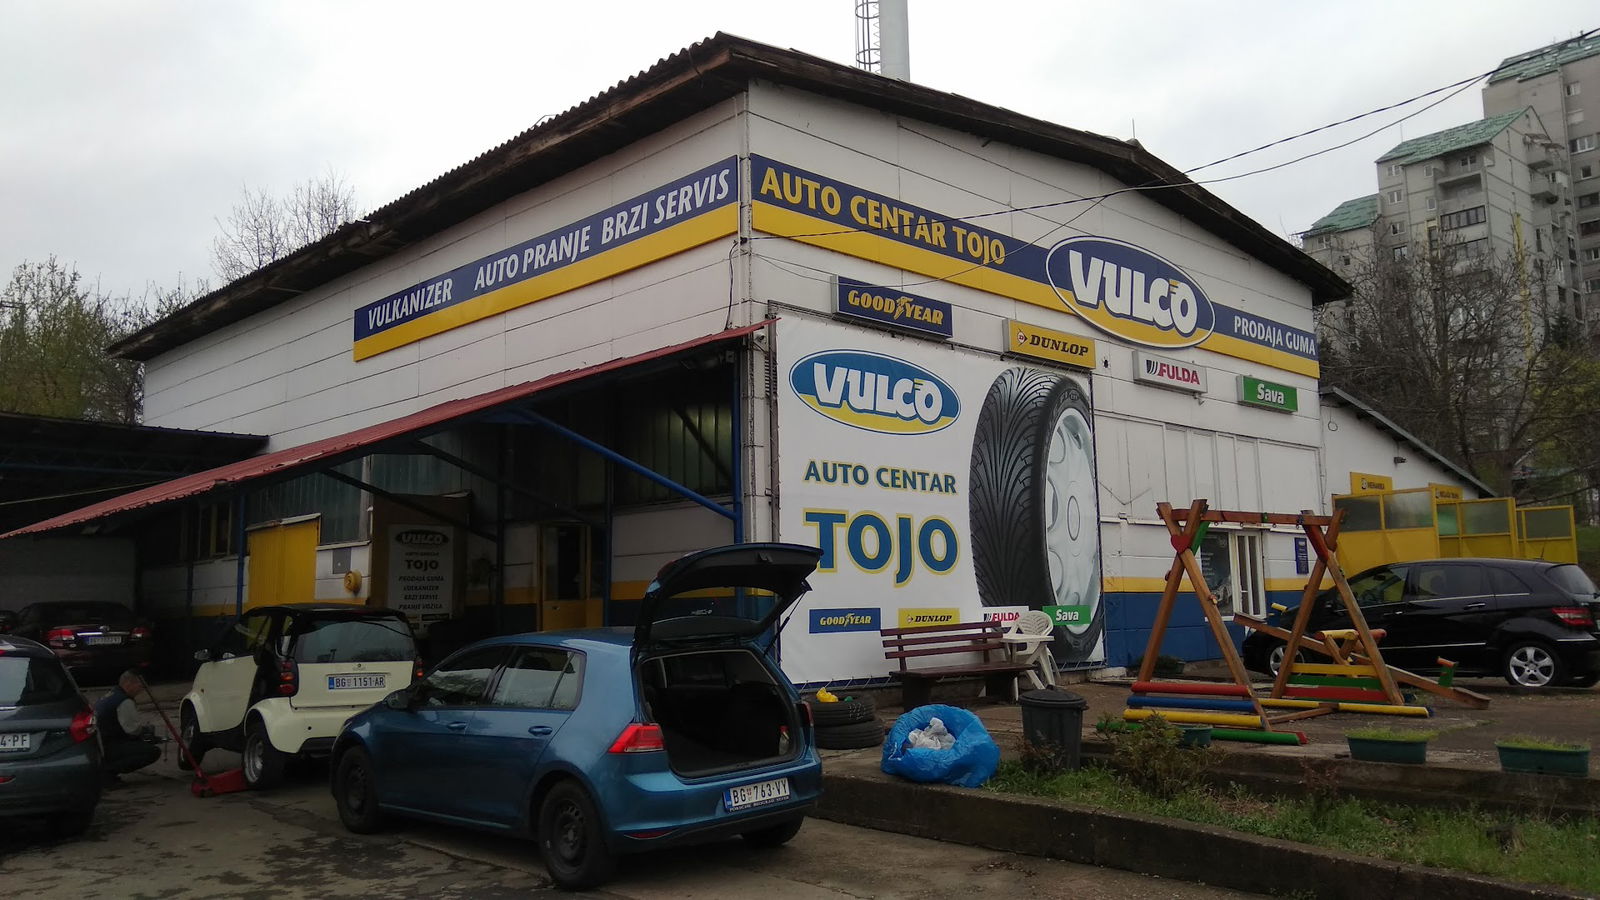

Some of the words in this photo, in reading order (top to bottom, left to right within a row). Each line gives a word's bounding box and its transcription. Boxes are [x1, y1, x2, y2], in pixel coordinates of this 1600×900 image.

[760, 166, 842, 216] AUTO
[850, 195, 947, 249] CENTAR
[953, 225, 1006, 265] TOJO
[368, 278, 453, 330] VULKANIZER
[474, 253, 519, 291] AUTO
[522, 226, 590, 274] PRANJE
[601, 202, 649, 245] BRZI
[654, 169, 730, 224] SERVIS
[1068, 249, 1198, 336] VULCO
[1029, 334, 1090, 357] DUNLOP
[1234, 315, 1283, 348] PRODAJA
[1285, 331, 1316, 356] GUMA
[1157, 361, 1200, 386] FULDA
[813, 362, 943, 424] VULCO
[1256, 382, 1285, 405] Sava
[804, 460, 869, 486] AUTO
[876, 467, 958, 494] CENTAR
[803, 508, 961, 588] TOJO
[405, 559, 439, 571] TOJO
[914, 614, 953, 624] DUNLOP
[991, 611, 1020, 623] FULDA
[1055, 608, 1080, 623] Sava
[335, 678, 346, 688] BG
[732, 788, 747, 804] BG
